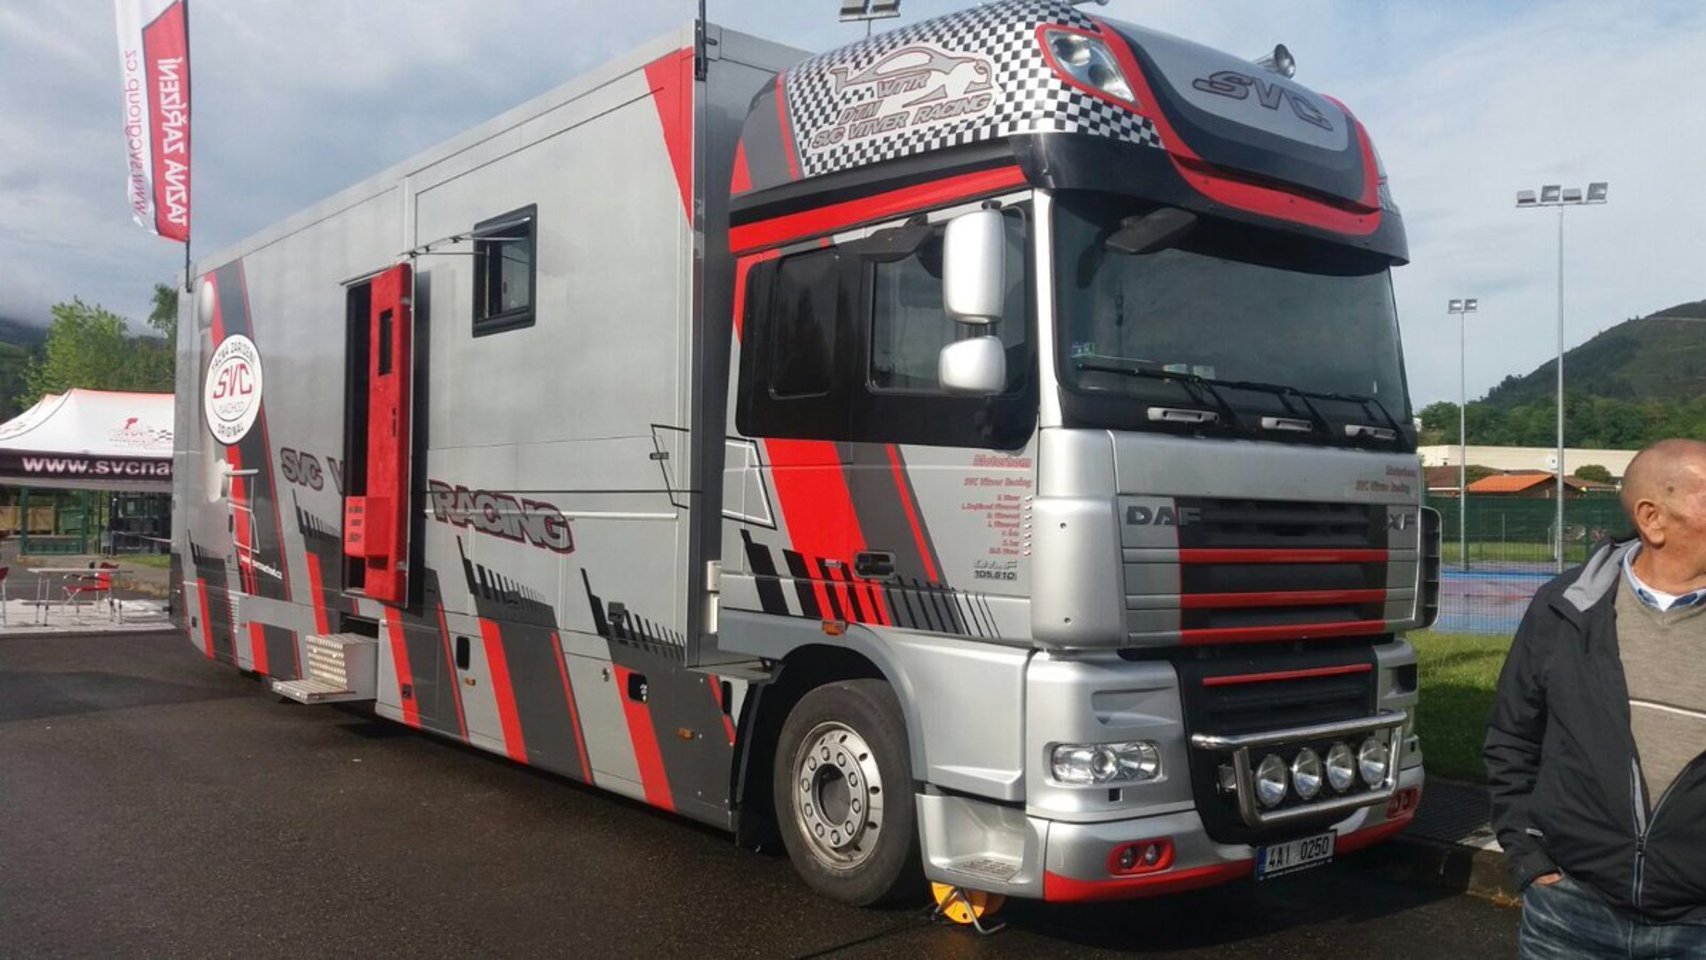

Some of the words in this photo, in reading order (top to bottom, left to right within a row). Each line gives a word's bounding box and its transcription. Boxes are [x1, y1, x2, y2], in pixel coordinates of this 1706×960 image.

[837, 99, 884, 126] DTM
[913, 93, 992, 124] RACING
[1192, 70, 1334, 132] SVC
[212, 362, 253, 399] SVC
[22, 456, 173, 476] www.svcna
[428, 479, 576, 554] RACING
[1126, 506, 1203, 526] DAF
[1300, 836, 1330, 861] 0250
